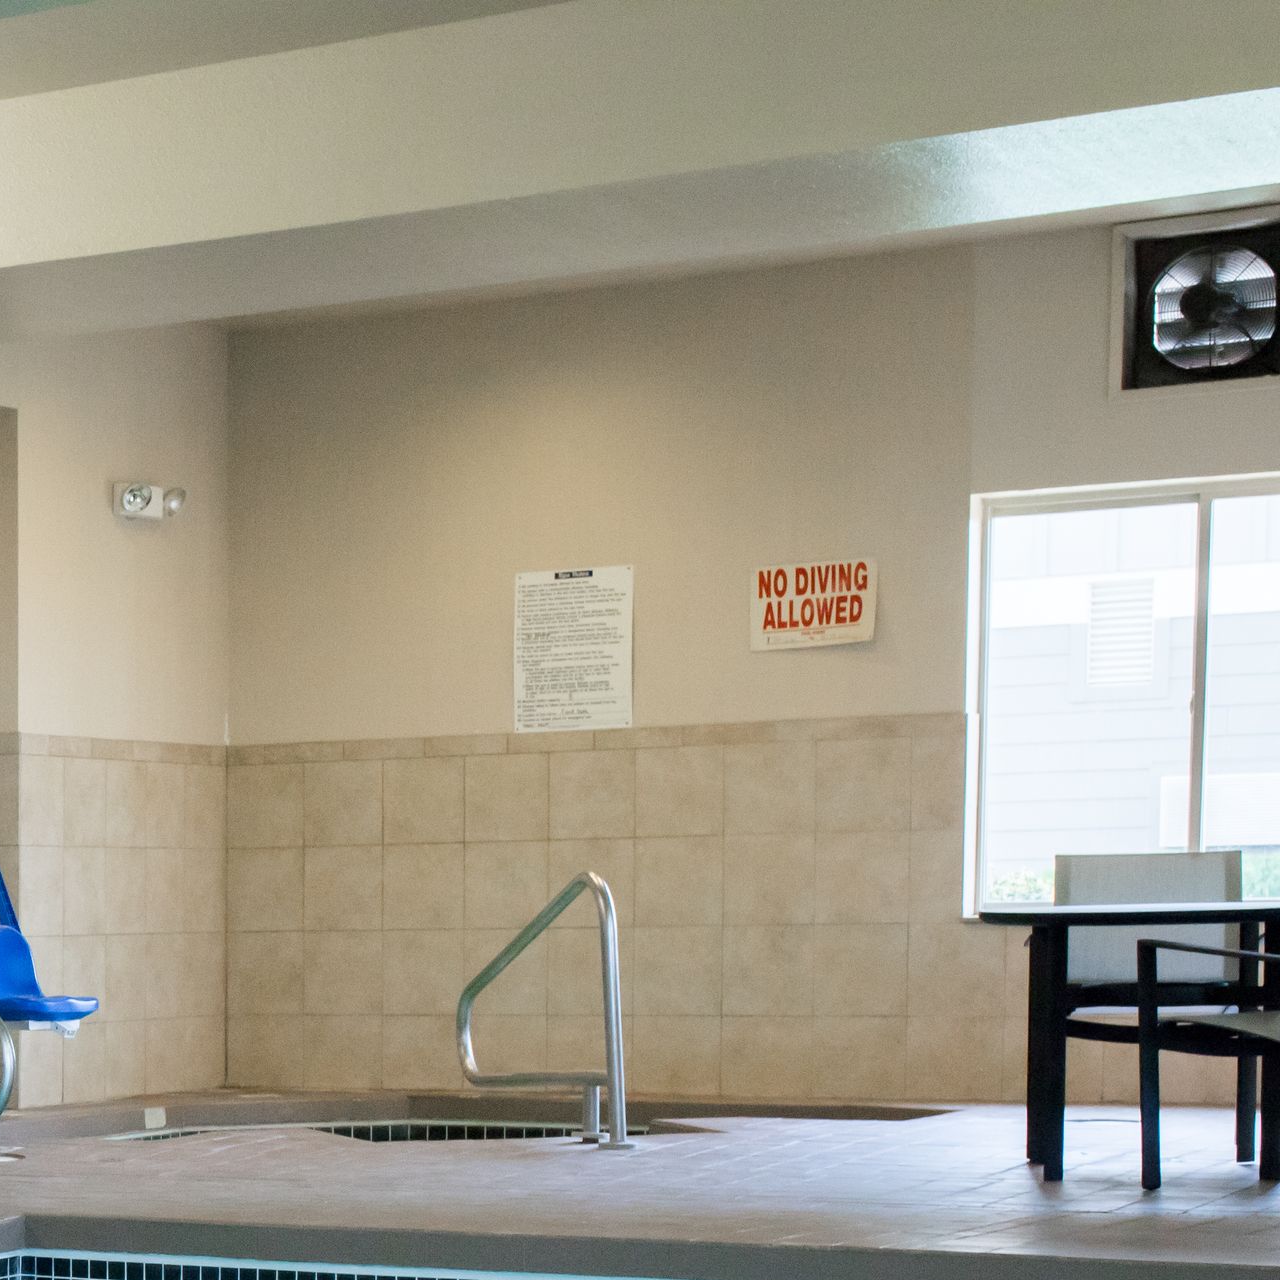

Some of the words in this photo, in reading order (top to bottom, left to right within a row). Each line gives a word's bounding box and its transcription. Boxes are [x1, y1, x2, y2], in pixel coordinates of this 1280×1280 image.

[758, 568, 788, 599] NO
[795, 561, 868, 596] DIVING
[763, 594, 863, 630] ALLOWED
